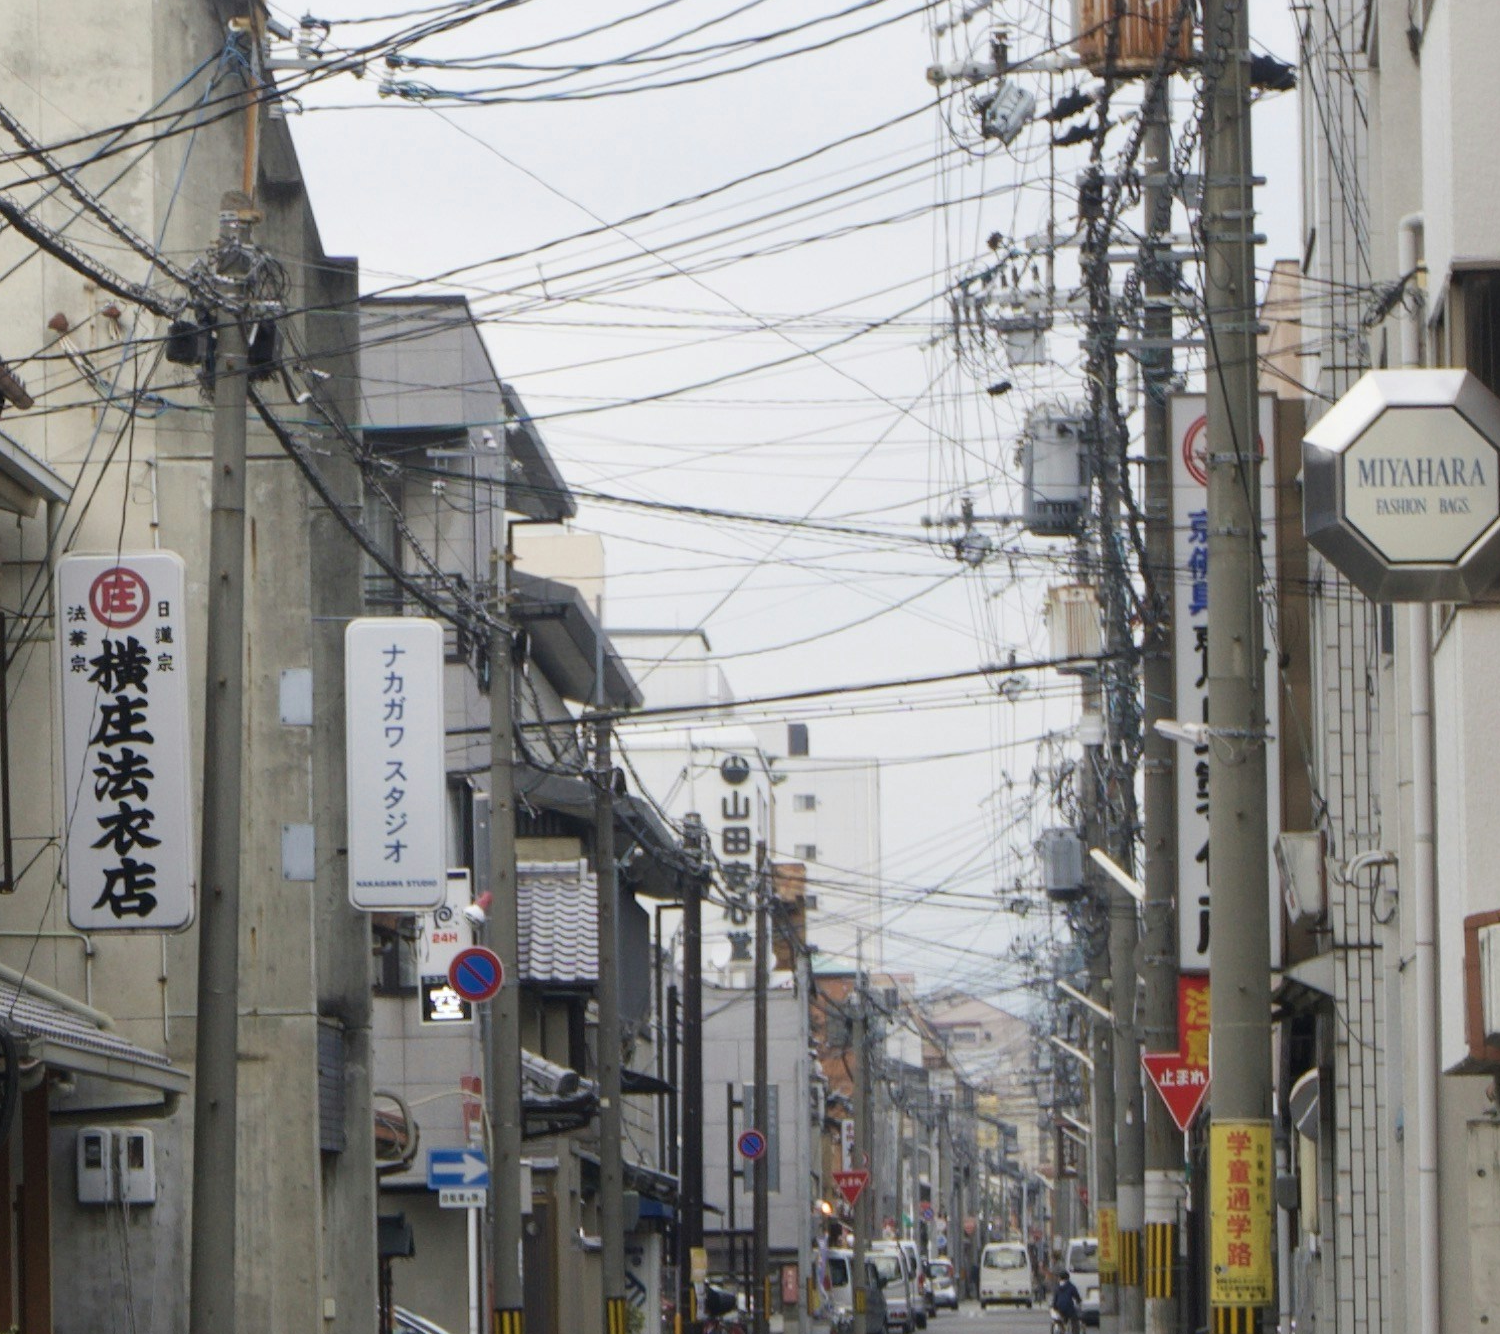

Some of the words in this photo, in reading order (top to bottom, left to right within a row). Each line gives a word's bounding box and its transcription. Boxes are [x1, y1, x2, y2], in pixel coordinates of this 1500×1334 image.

[1357, 457, 1485, 488] MIYAHARA
[1376, 498, 1427, 515] FASHION
[382, 644, 406, 748] ナカガワ
[88, 635, 162, 920] 横庄法衣店
[384, 761, 408, 864] スタジオ
[407, 879, 437, 887] STUDIO
[432, 932, 458, 944] 24H
[1159, 1068, 1206, 1087] 止まれ
[1227, 1131, 1252, 1267] 学童通学路
